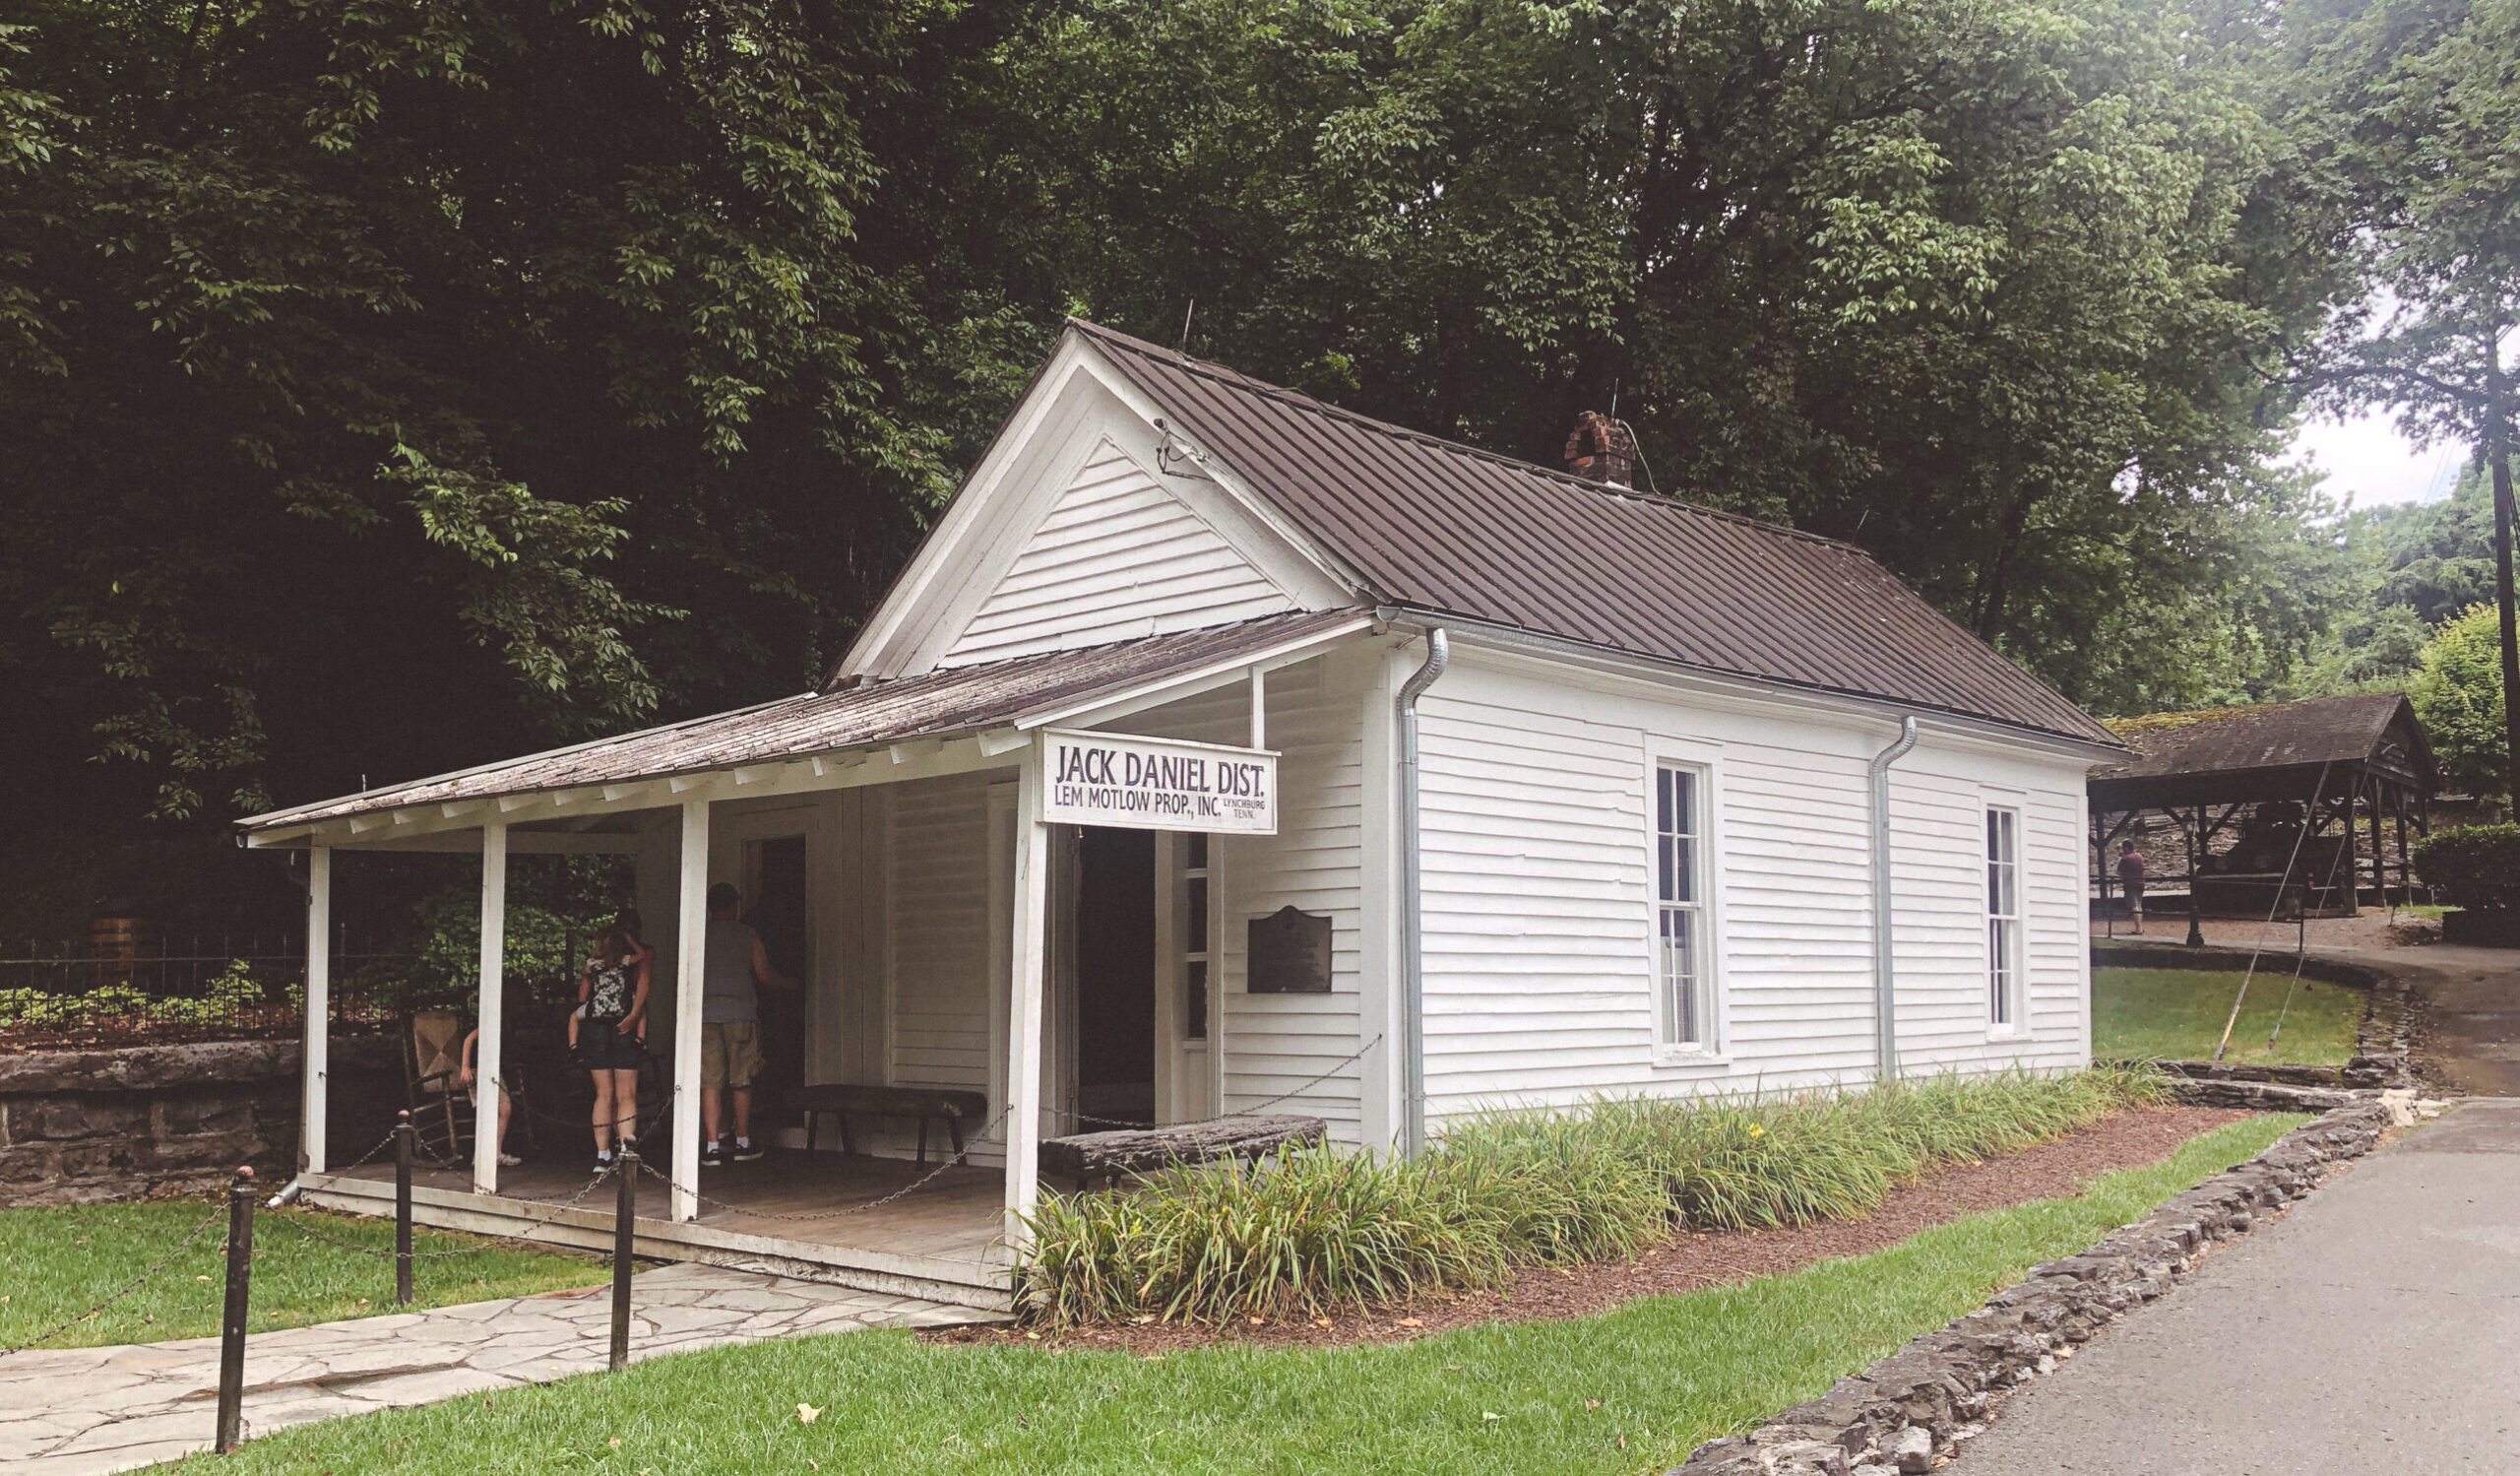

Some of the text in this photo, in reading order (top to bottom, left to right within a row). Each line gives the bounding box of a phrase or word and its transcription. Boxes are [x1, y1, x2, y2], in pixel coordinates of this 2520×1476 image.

[1056, 745, 1265, 798] JACK DANIEL DIST.
[1055, 785, 1222, 820] LEM MOTLOW PROP., INC.
[1224, 798, 1265, 810] LYNCHBURG
